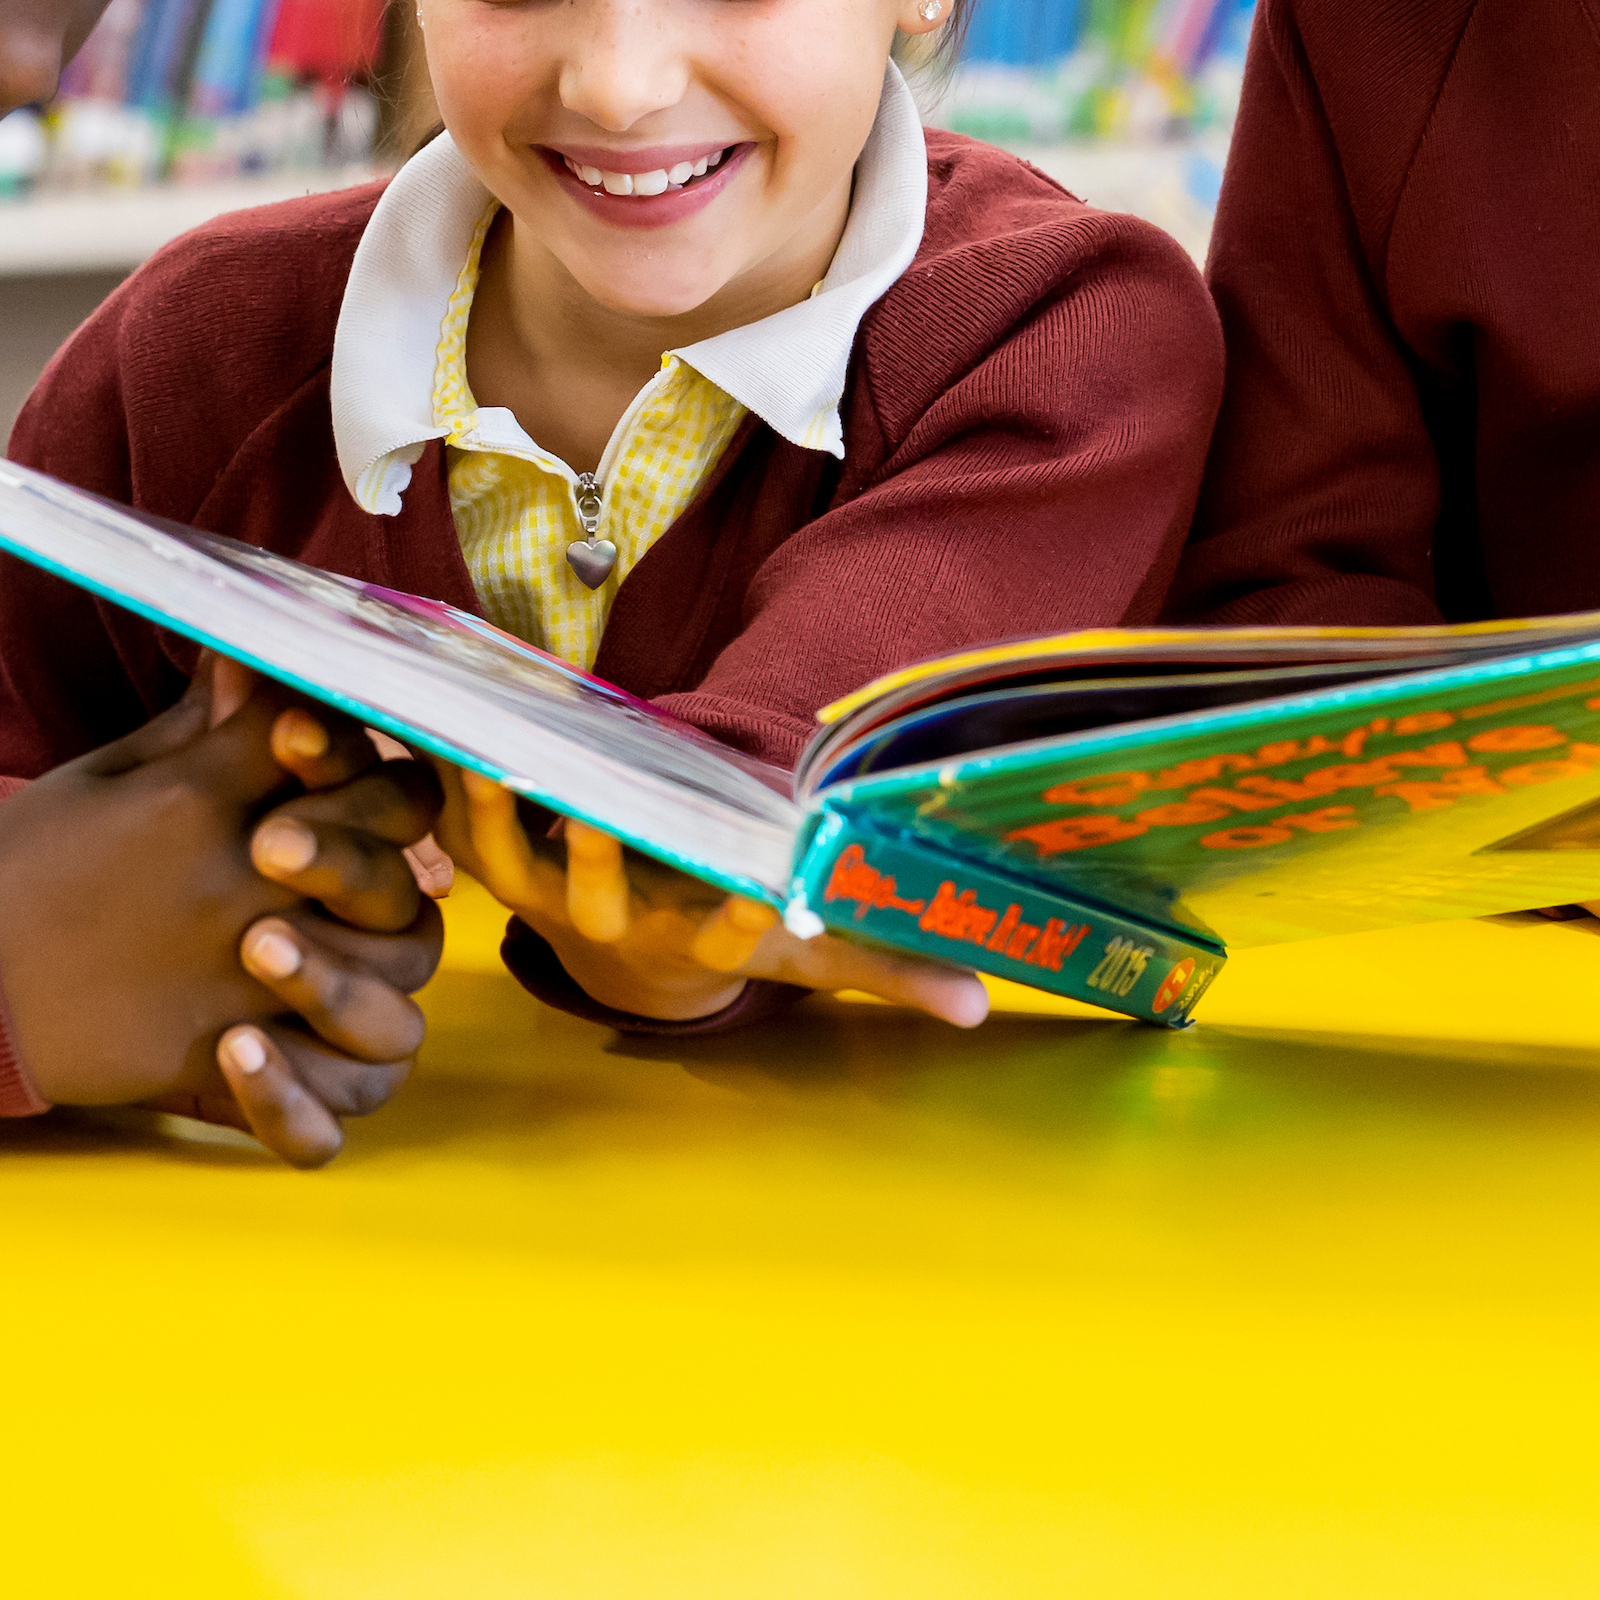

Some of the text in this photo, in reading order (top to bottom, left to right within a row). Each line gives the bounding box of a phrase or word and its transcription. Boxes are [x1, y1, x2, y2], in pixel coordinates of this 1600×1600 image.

[1002, 724, 1568, 857] Believe
[1199, 804, 1362, 850] or
[1086, 936, 1155, 997] 2015
